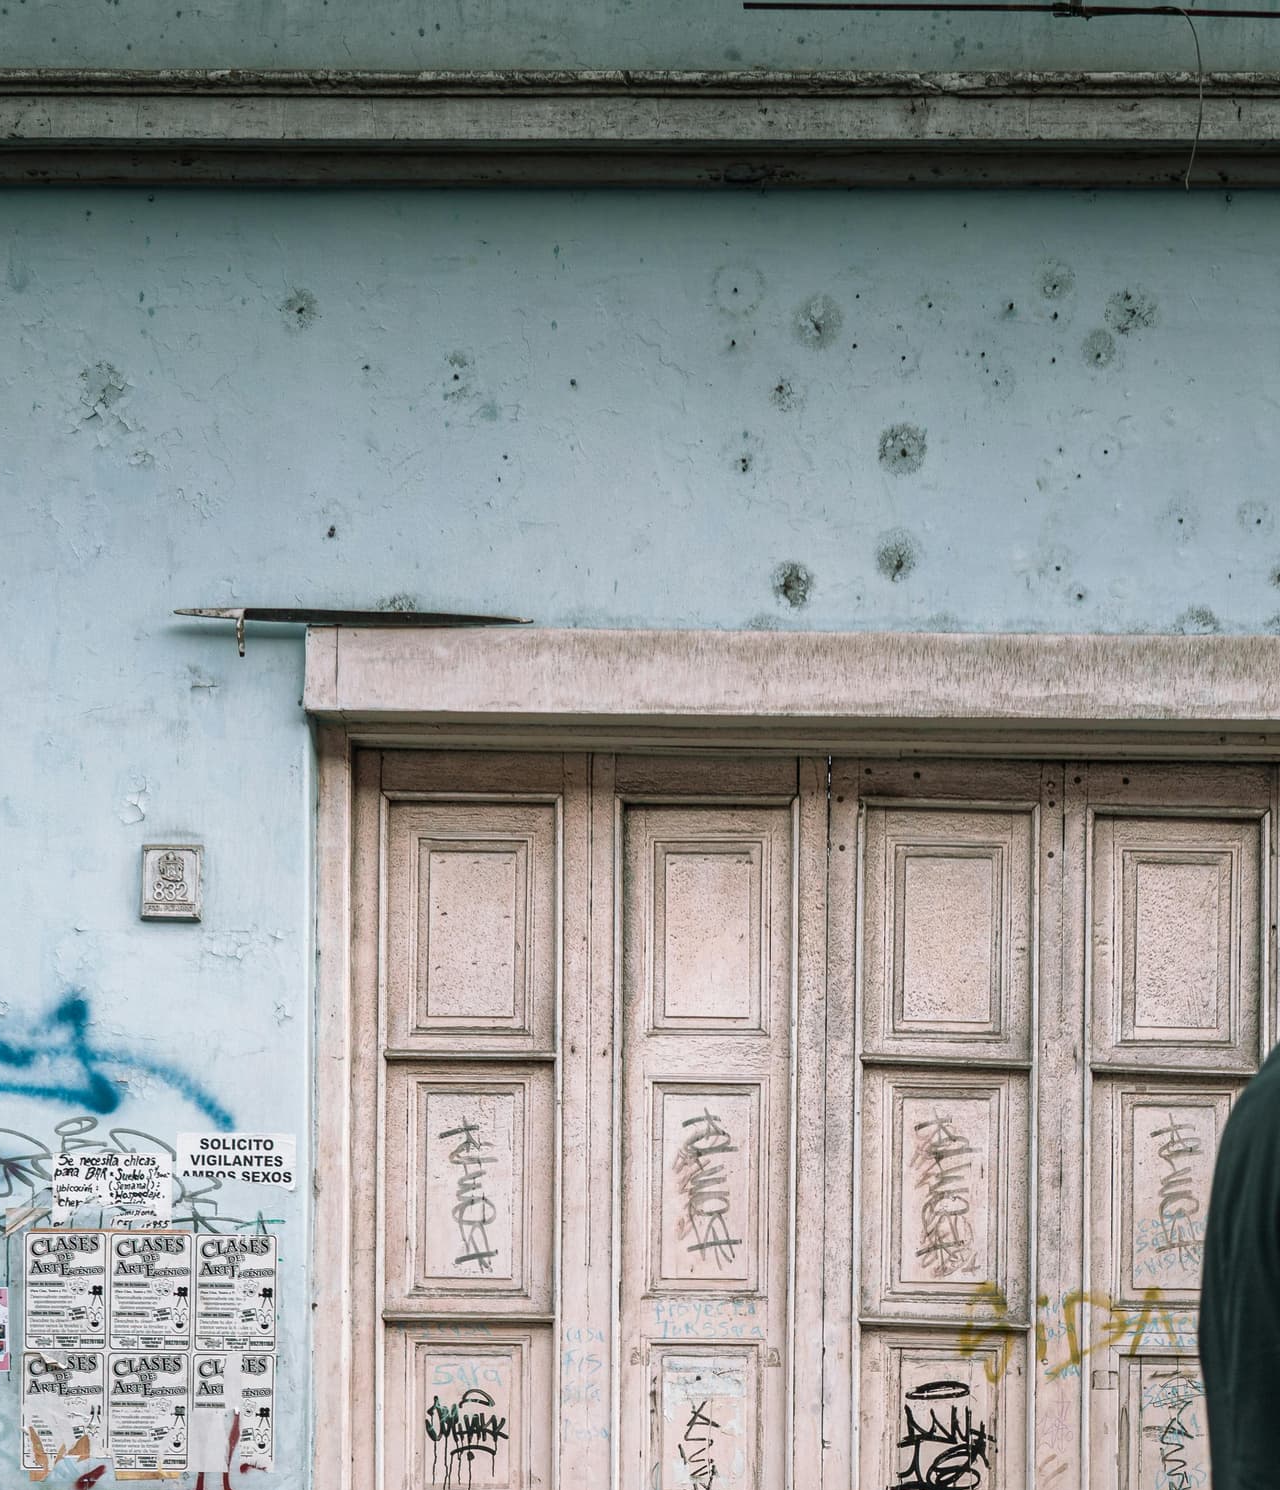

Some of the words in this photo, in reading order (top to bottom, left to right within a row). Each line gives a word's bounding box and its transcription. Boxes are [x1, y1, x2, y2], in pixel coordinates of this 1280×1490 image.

[153, 881, 188, 901] 832
[200, 1138, 274, 1151] SOLICITO
[190, 1154, 284, 1167] VIGILANTES
[241, 1171, 292, 1183] SEXOS
[31, 1235, 100, 1256] CLASES
[115, 1237, 185, 1258] CLASES
[200, 1238, 270, 1258] CLASES
[28, 1355, 98, 1376] CLSES
[112, 1355, 182, 1377] CLASES
